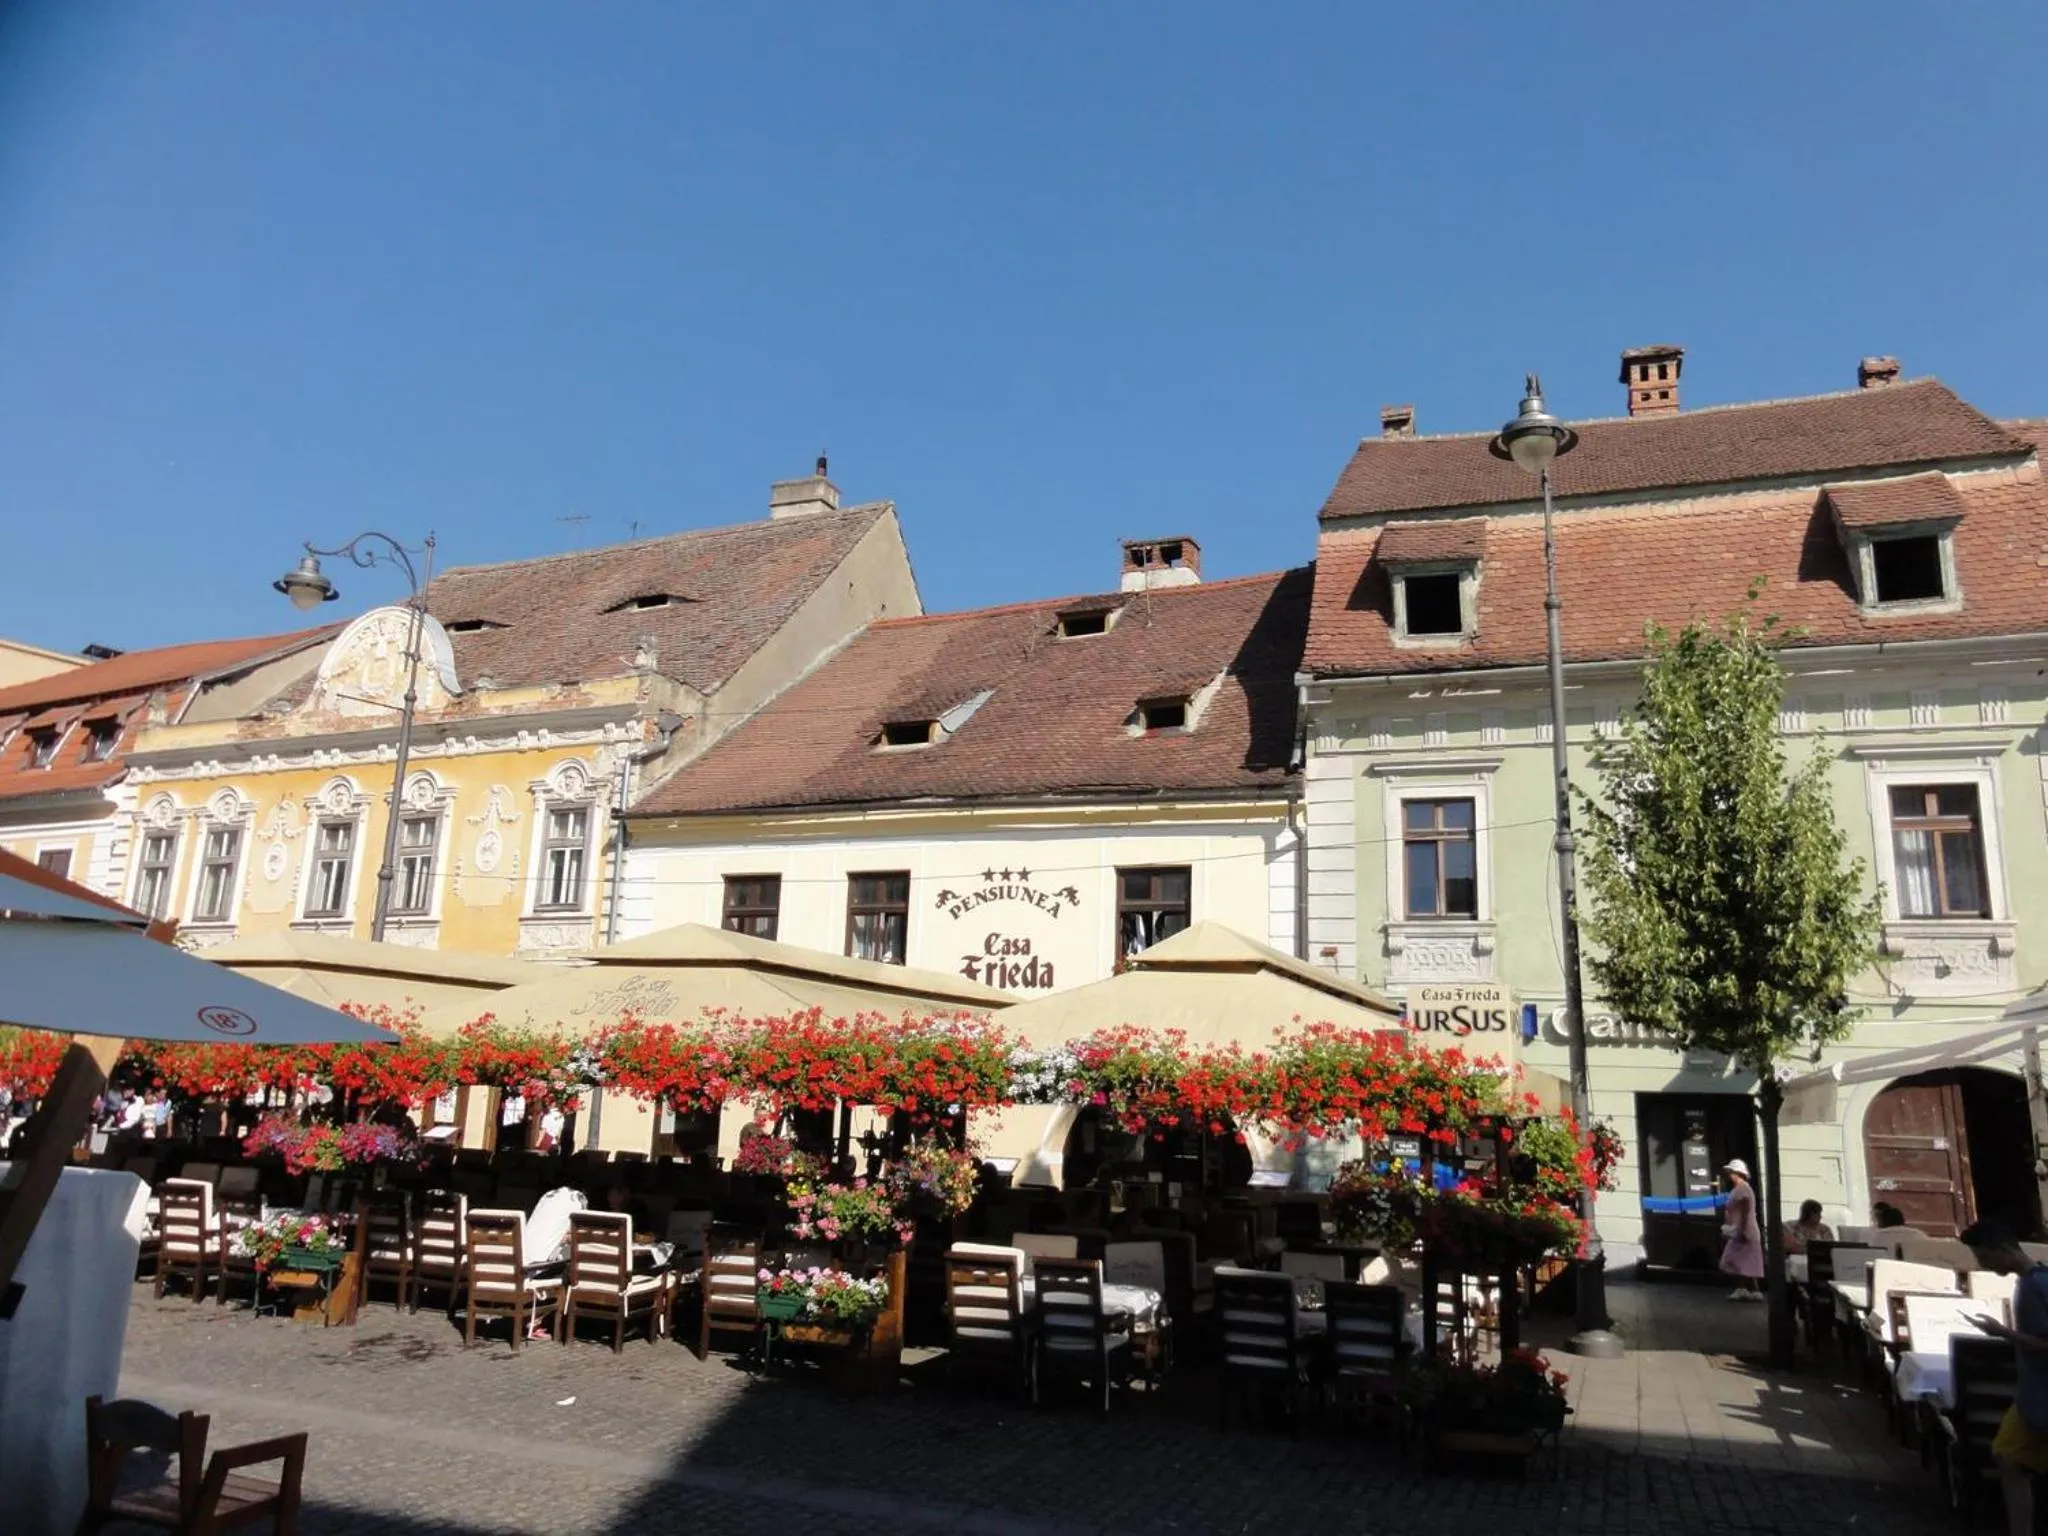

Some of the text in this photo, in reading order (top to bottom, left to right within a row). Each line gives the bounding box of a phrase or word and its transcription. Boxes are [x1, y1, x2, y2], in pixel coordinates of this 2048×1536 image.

[949, 885, 1061, 920] PENSIUNEA
[984, 932, 1031, 956] Casa
[960, 955, 1055, 990] Frieda
[1421, 987, 1500, 1001] Casa Frieda
[1413, 1005, 1507, 1037] URSUS
